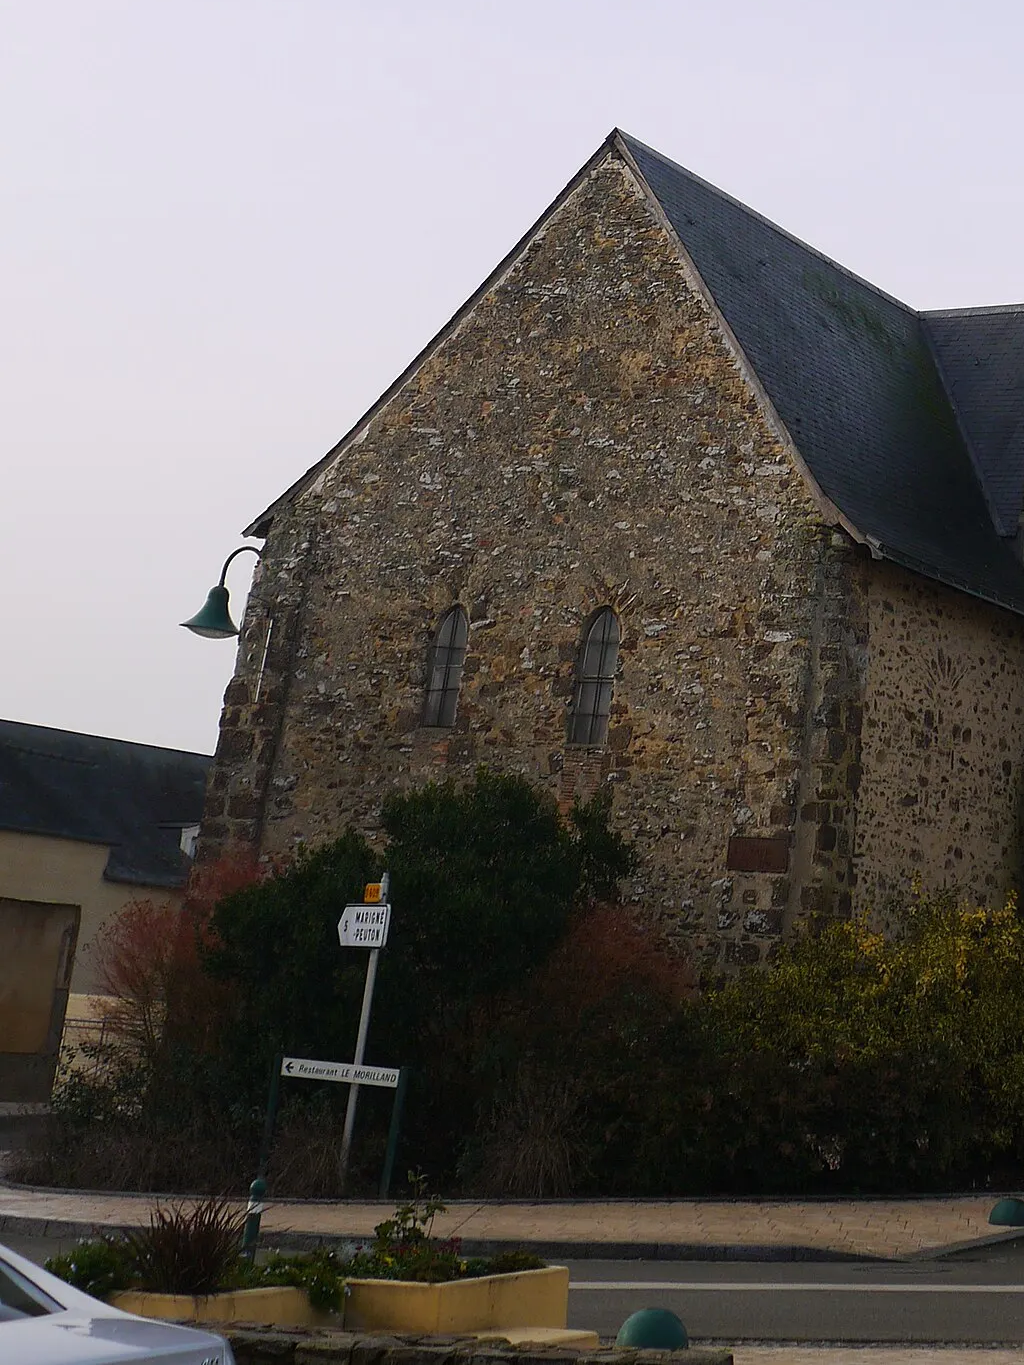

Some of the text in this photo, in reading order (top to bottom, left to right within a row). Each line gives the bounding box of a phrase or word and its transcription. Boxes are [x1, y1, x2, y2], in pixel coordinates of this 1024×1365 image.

[355, 909, 385, 924] MARIGNÉ
[298, 1065, 397, 1083] Restaurant LE MORILLAND
